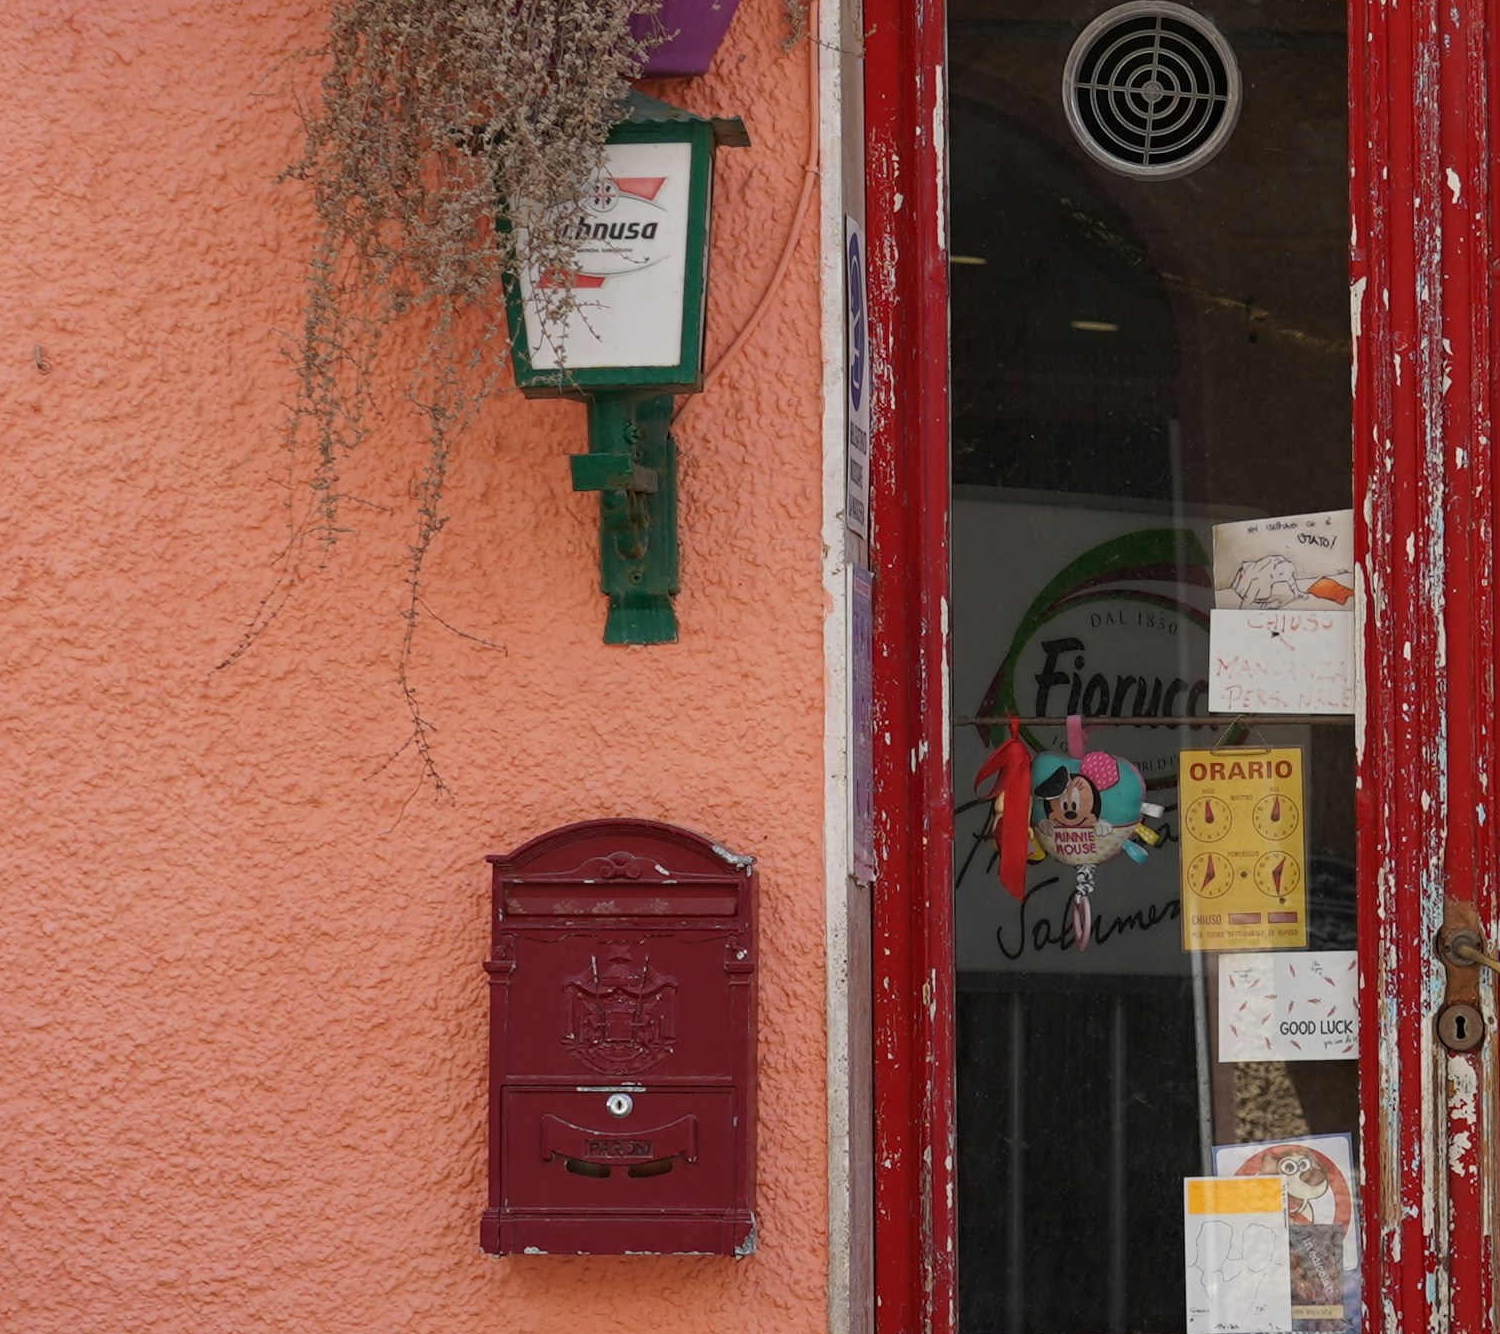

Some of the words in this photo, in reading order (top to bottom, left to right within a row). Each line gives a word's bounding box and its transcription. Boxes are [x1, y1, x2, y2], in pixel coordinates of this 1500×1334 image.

[1090, 610, 1127, 628] DAL
[1138, 612, 1178, 636] 1850
[1034, 637, 1210, 729] Fiorucc
[1189, 760, 1293, 781] ORARIO
[1054, 831, 1096, 843] MINNIE
[1056, 843, 1097, 856] MOUSE
[1191, 914, 1222, 926] CHIUSO
[1280, 1021, 1316, 1035] GOOD
[1320, 1020, 1353, 1034] LUCK
